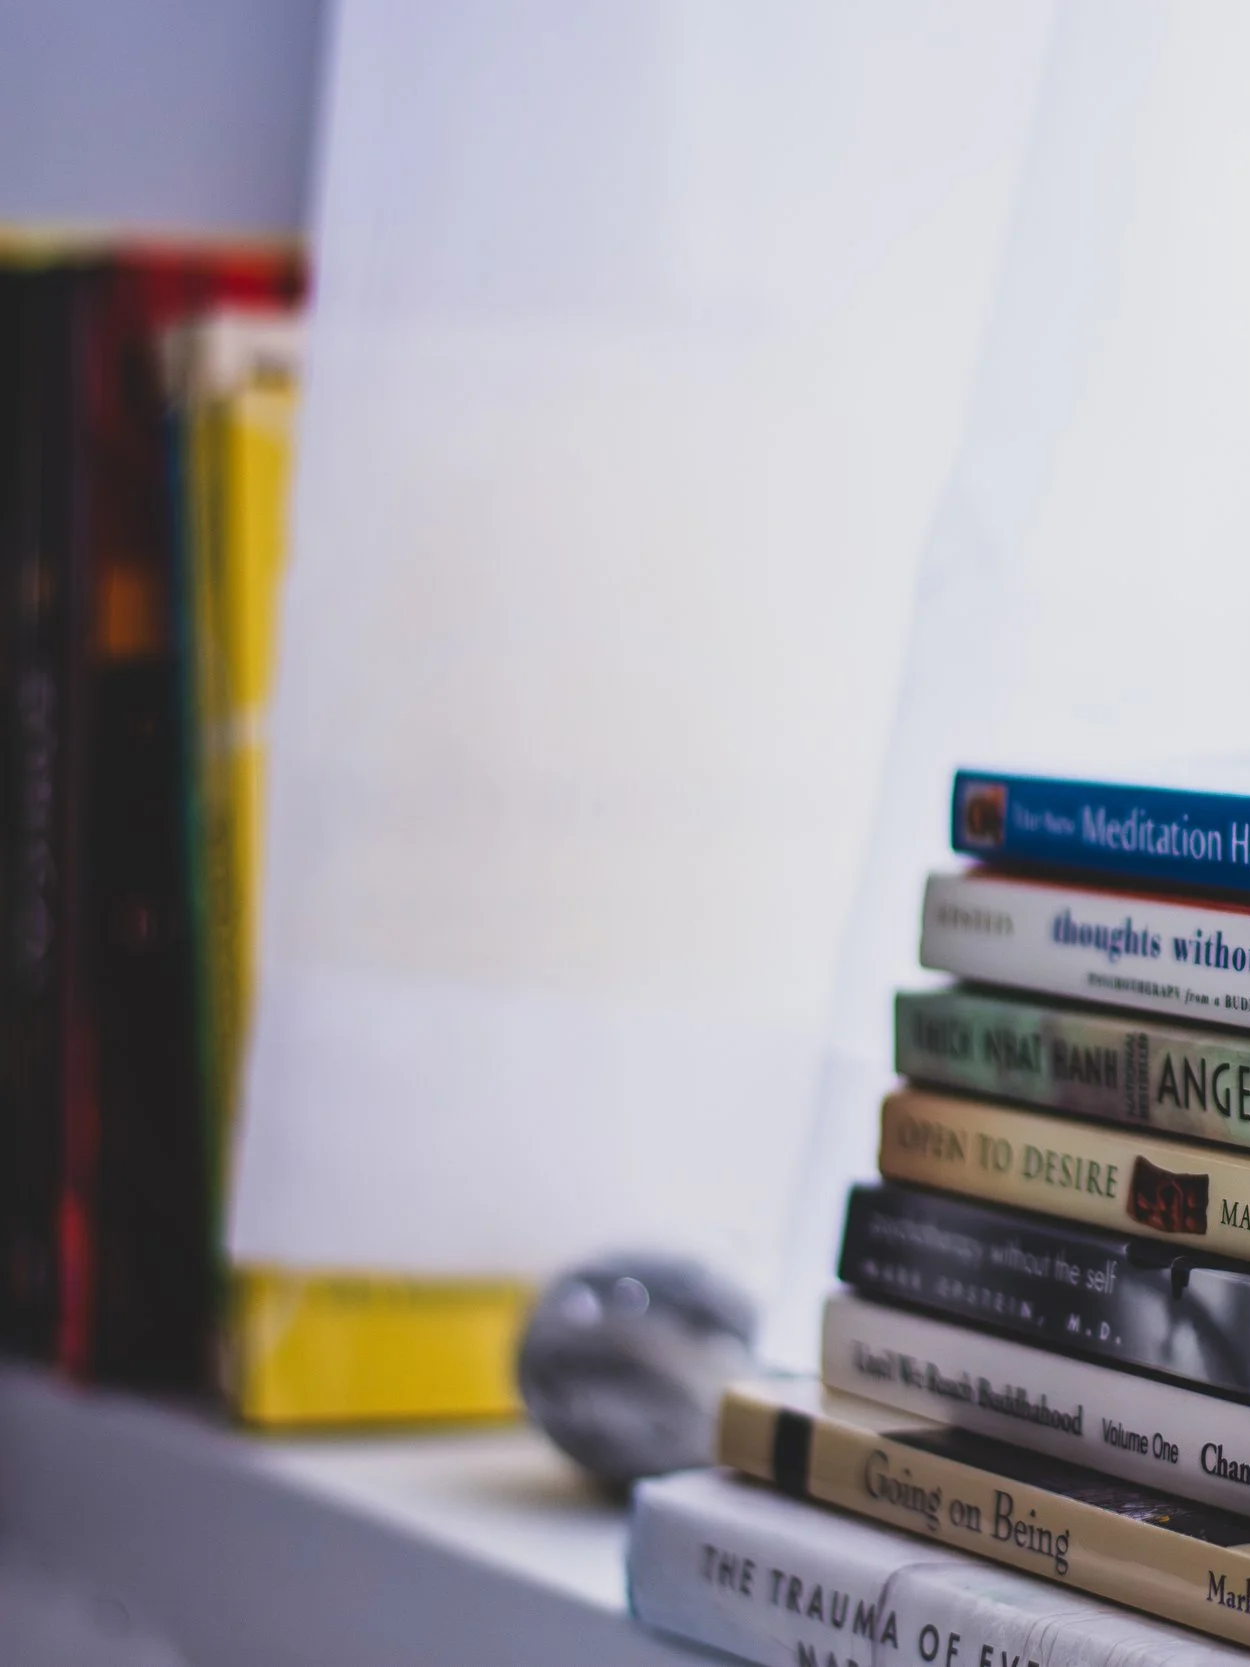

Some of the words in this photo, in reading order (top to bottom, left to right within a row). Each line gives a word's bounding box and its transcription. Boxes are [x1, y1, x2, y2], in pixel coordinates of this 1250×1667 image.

[1082, 804, 1222, 862] Meditation
[1051, 907, 1162, 963] thoughts
[1184, 988, 1209, 1006] from
[976, 1132, 1011, 1172] TO
[1023, 1144, 1118, 1199] DESIRE
[1054, 1250, 1081, 1286] the
[1085, 1260, 1117, 1295] self
[1102, 1417, 1148, 1454] Volume
[1153, 1433, 1179, 1464] One
[1201, 1442, 1250, 1486] Chan
[864, 1450, 942, 1530] Going
[950, 1500, 981, 1532] on
[993, 1489, 1070, 1576] Being
[703, 1543, 756, 1597] THE
[769, 1568, 898, 1650] TRAUMA
[920, 1623, 960, 1667] OF
